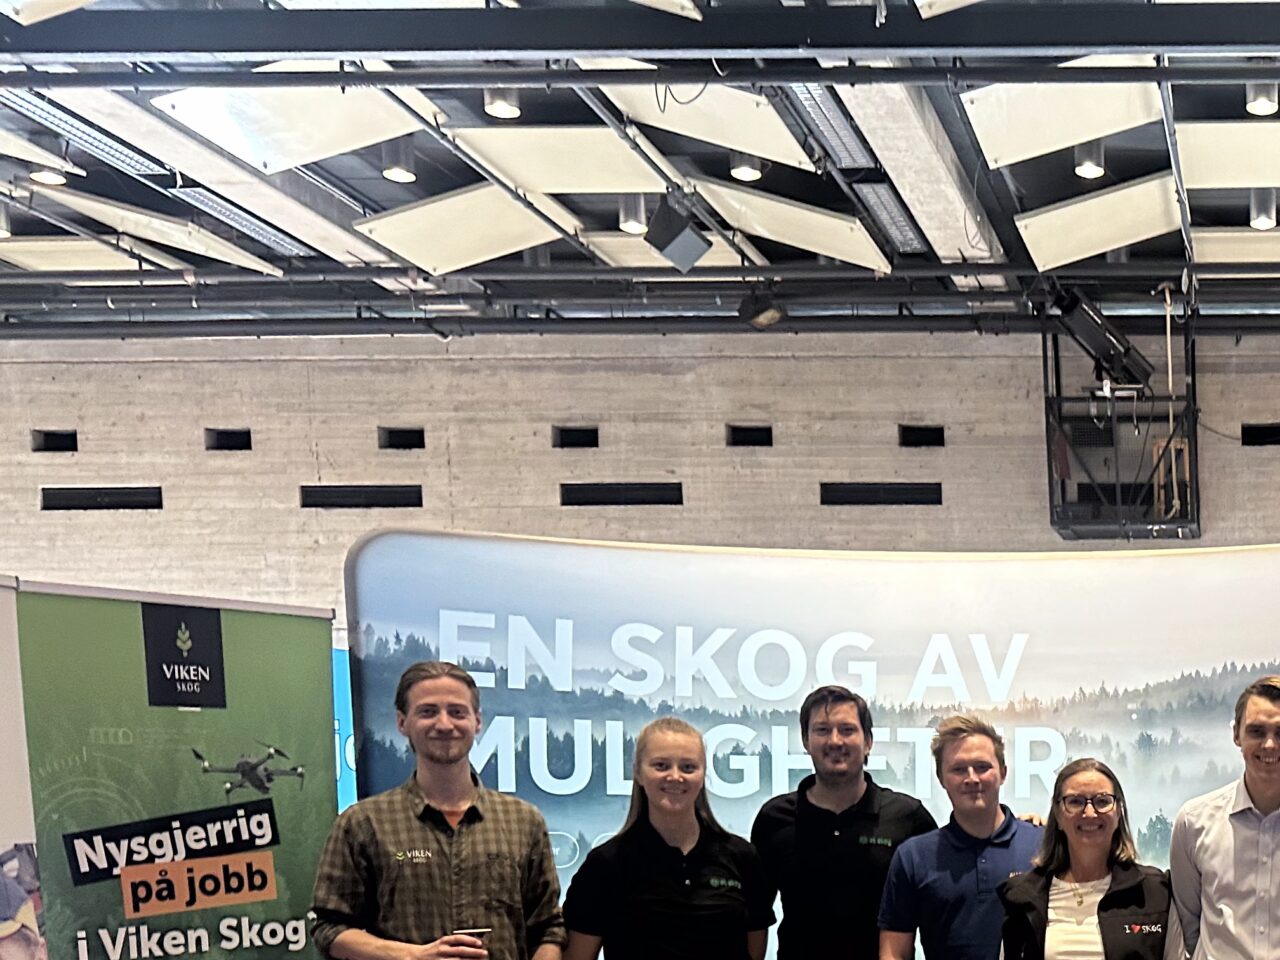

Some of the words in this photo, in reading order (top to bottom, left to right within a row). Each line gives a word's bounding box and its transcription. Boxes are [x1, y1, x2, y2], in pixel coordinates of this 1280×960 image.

[438, 609, 574, 691] EN
[608, 622, 879, 701] SKOG
[908, 633, 1030, 702] AV
[162, 664, 210, 681] VIKEN
[176, 682, 201, 693] SKOG
[73, 809, 273, 875] Nysgjerrig
[406, 850, 432, 858] VIKEN
[130, 869, 176, 913] på
[185, 862, 268, 907] jobb
[1124, 924, 1131, 933] I
[1141, 924, 1162, 934] SKOG
